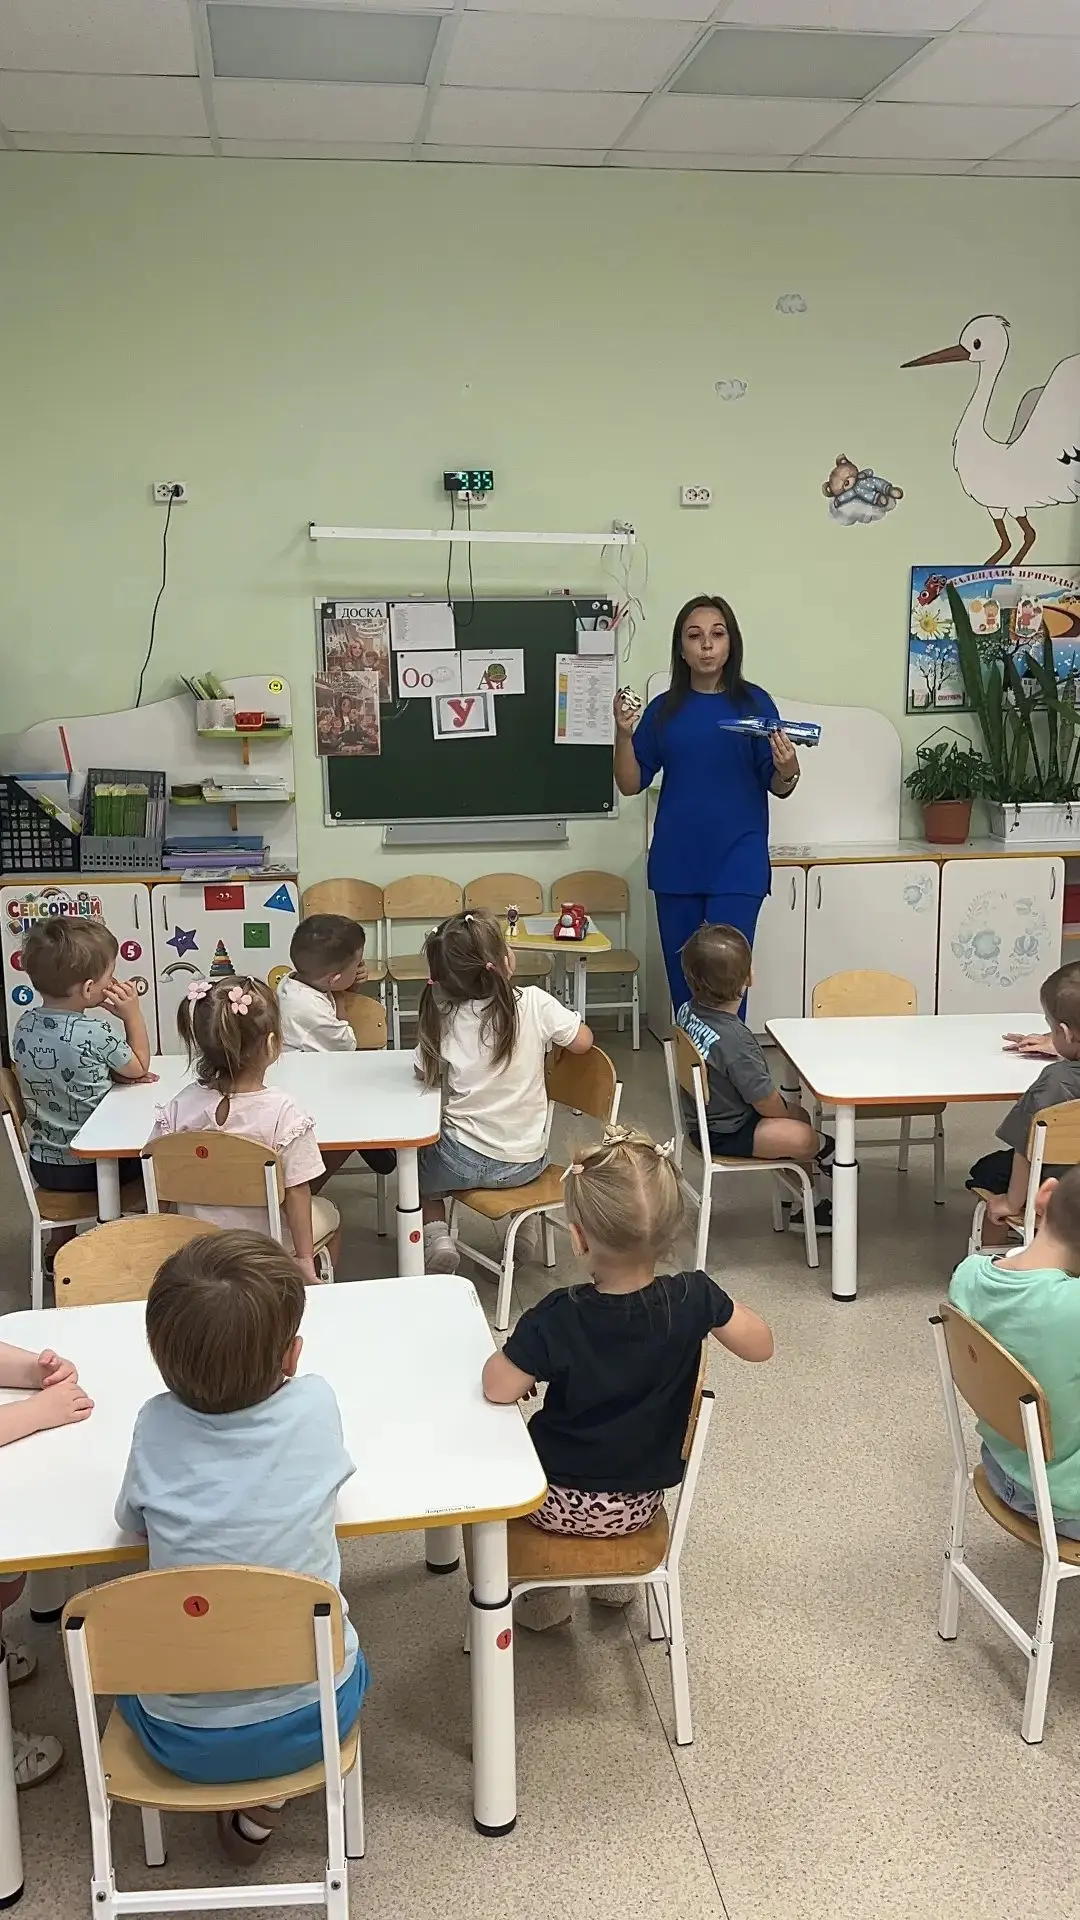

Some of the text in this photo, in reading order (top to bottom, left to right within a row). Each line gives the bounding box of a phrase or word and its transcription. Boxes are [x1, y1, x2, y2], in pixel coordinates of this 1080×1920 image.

[341, 607, 383, 619] ДОСКА
[126, 945, 136, 958] 5
[18, 989, 28, 1003] 6
